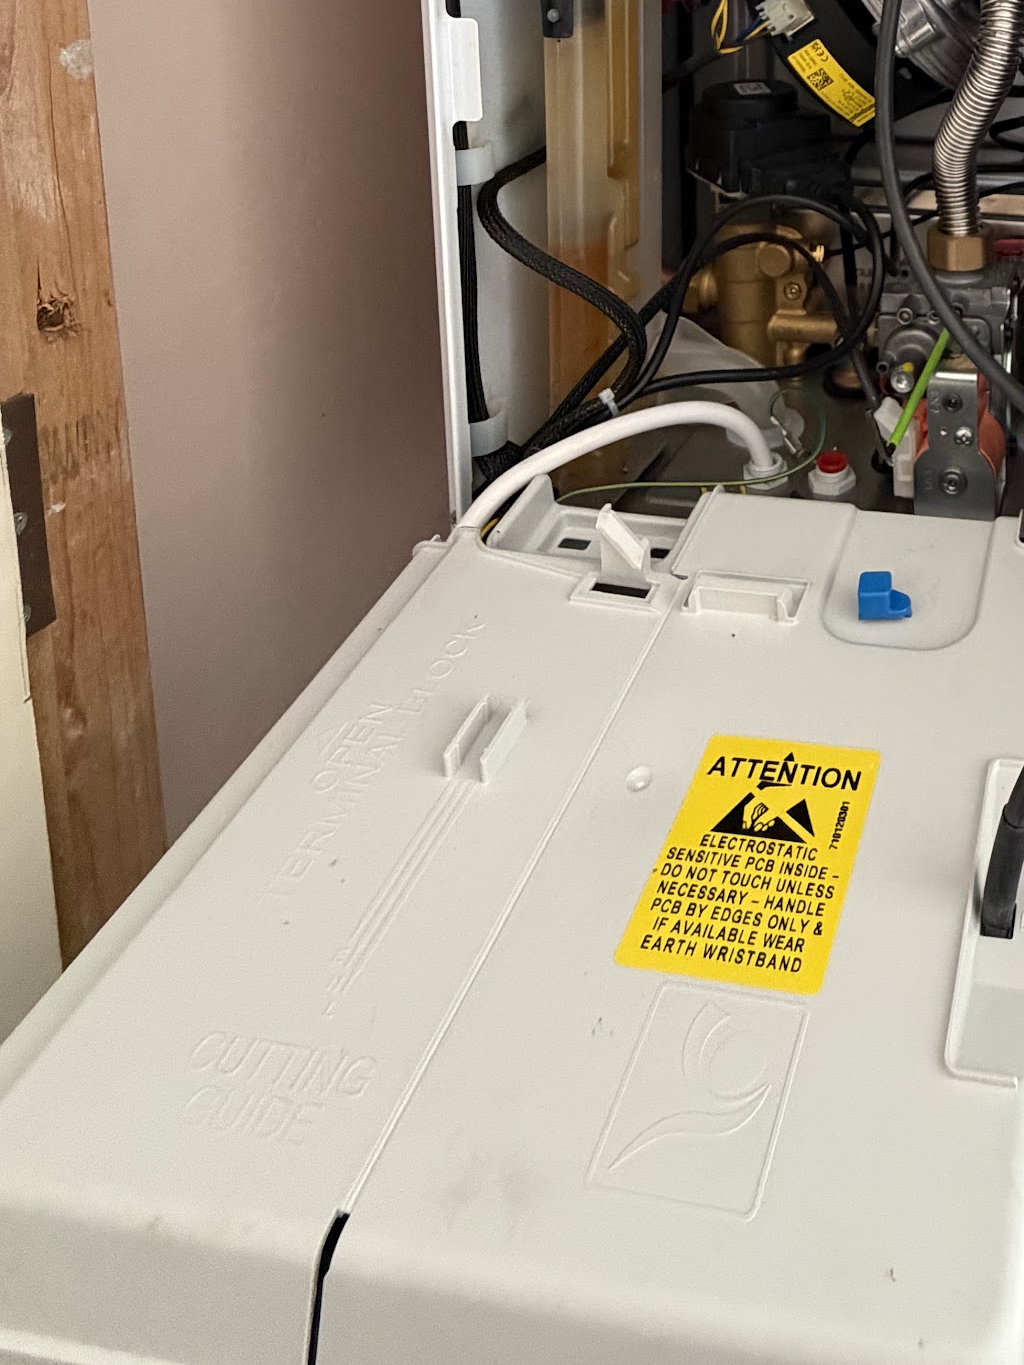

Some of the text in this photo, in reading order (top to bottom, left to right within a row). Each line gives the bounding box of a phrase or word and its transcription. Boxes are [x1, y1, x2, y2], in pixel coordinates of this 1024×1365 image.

[707, 756, 861, 791] ATTENTION
[829, 801, 850, 850] 710120301
[666, 847, 740, 868] SENSITIVE
[744, 857, 774, 872] PCB
[780, 862, 828, 880] INSIDE
[700, 834, 818, 862] ELECTROSTATIC
[657, 880, 748, 905] NECESSARY
[764, 896, 825, 917] HANDLE
[660, 863, 835, 899] DO NOT TOUCH UNLESS
[650, 898, 823, 936] PCB BY EDGES ONLY &
[652, 917, 805, 953] IF AVAILABLE WEAR
[640, 935, 802, 973] EARTH WRISTBAND
